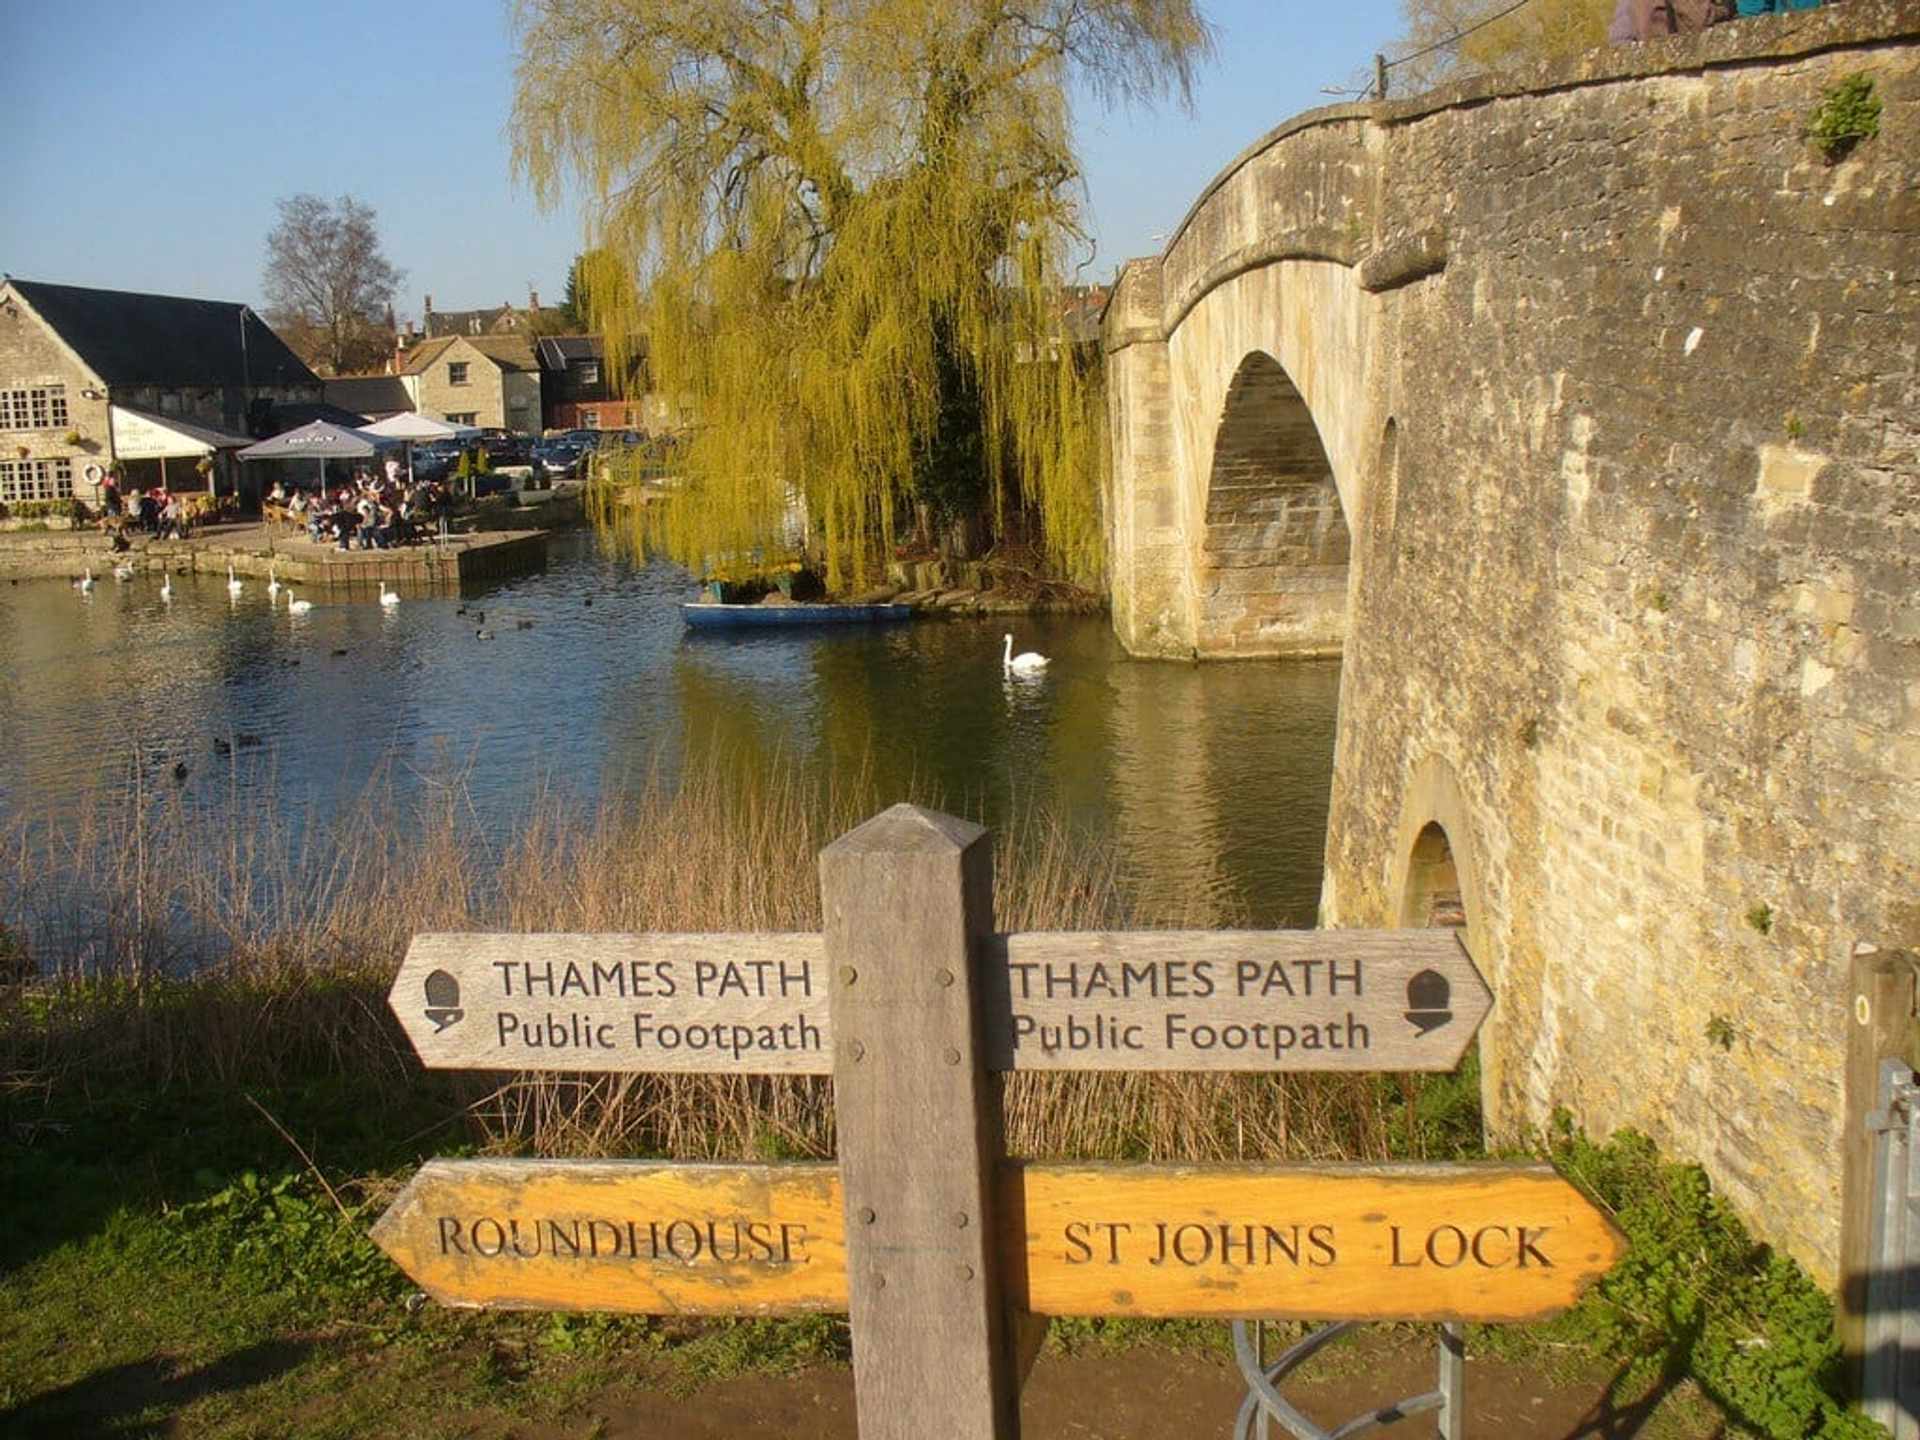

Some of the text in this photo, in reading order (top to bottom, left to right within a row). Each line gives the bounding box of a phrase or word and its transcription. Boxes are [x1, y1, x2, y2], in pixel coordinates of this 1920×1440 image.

[493, 960, 811, 997] THAMES PATH
[1009, 959, 1363, 999] THAMES PATH
[498, 1012, 821, 1059] Public Footpath
[1012, 1013, 1369, 1059] Public Footpath
[438, 1216, 811, 1264] ROUNDHOUSE
[1064, 1222, 1553, 1268] ST JOHNS LOCK
